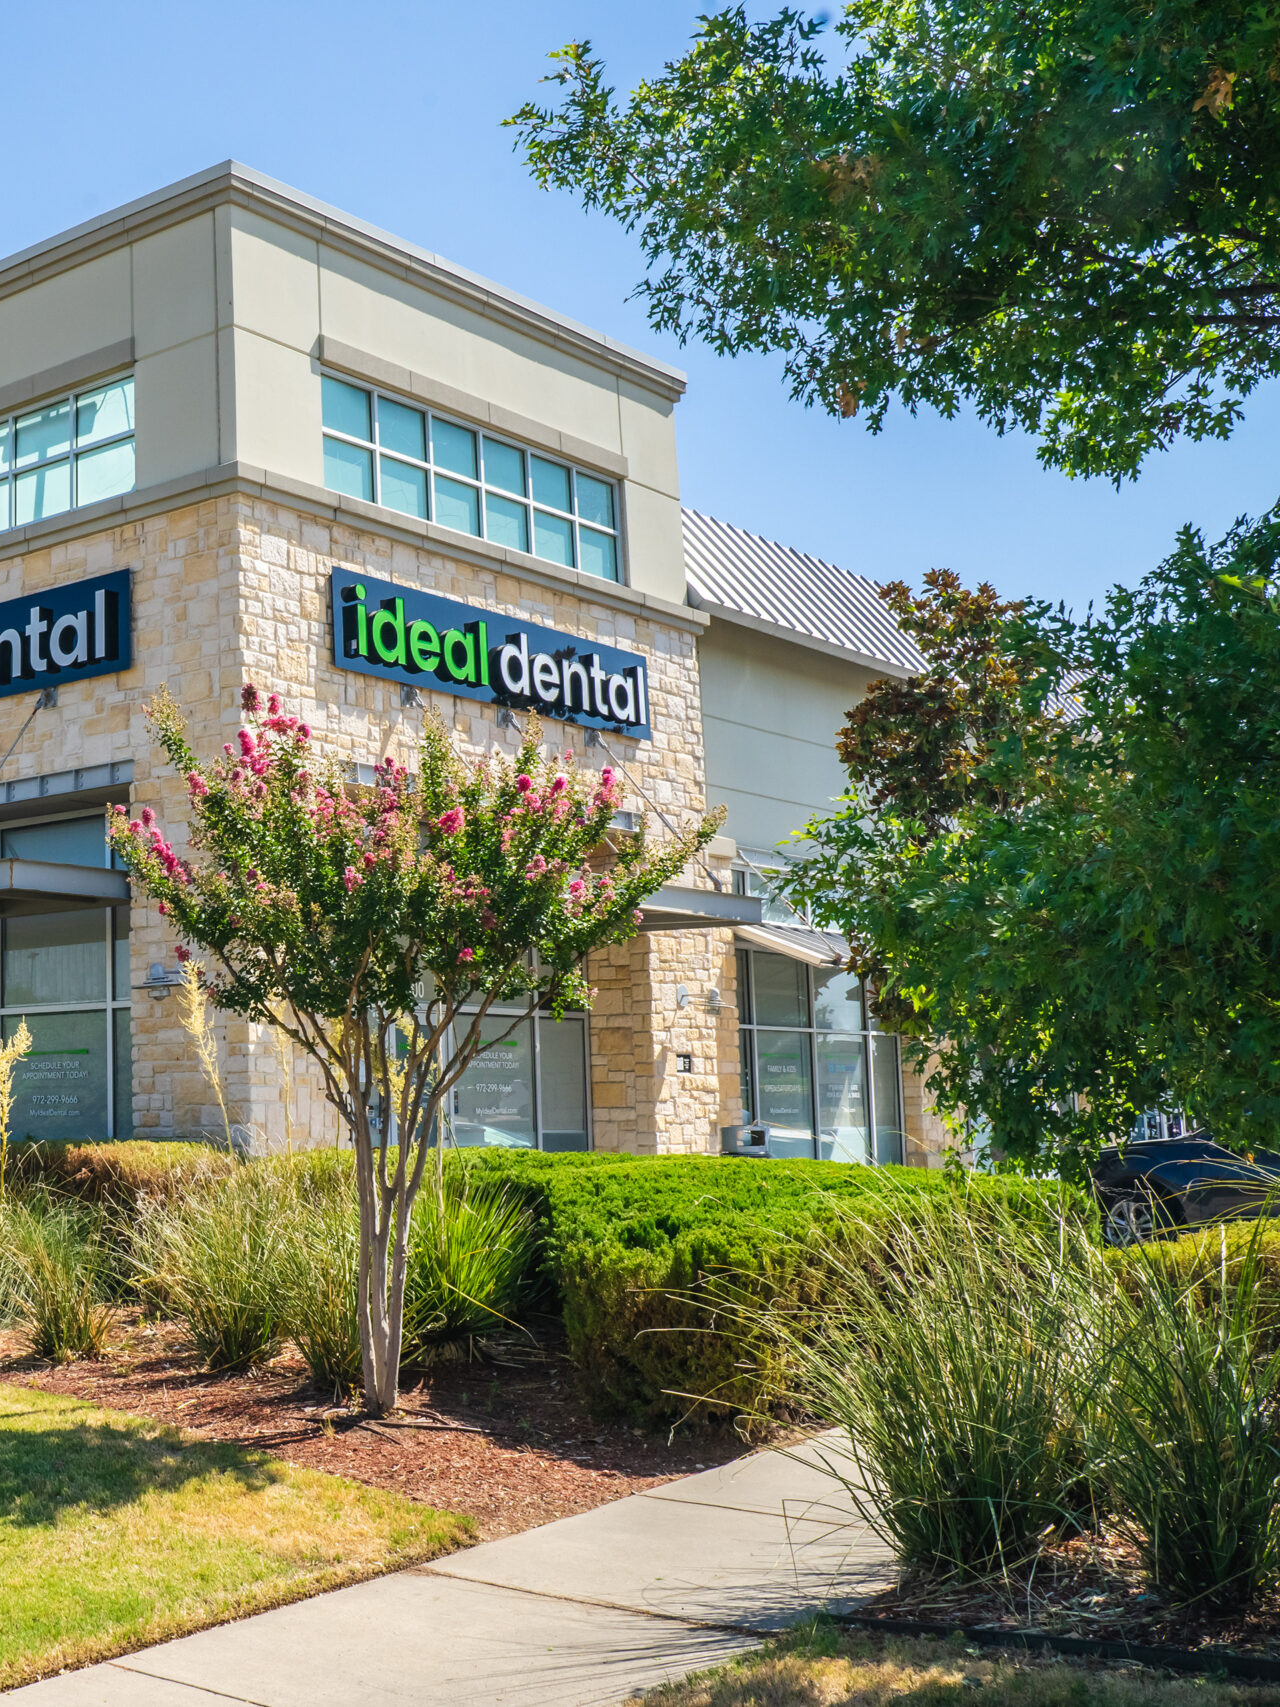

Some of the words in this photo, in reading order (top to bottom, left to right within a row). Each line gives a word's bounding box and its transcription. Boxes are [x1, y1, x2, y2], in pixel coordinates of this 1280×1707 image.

[353, 583, 489, 686] ideal
[500, 631, 647, 725] dental
[30, 1061, 62, 1070] SCHEDULE
[62, 1060, 80, 1069] YOUR
[22, 1070, 64, 1080] APPOINTMENT
[65, 1070, 89, 1079] TODAY!
[32, 1095, 79, 1105] 972-299-9666
